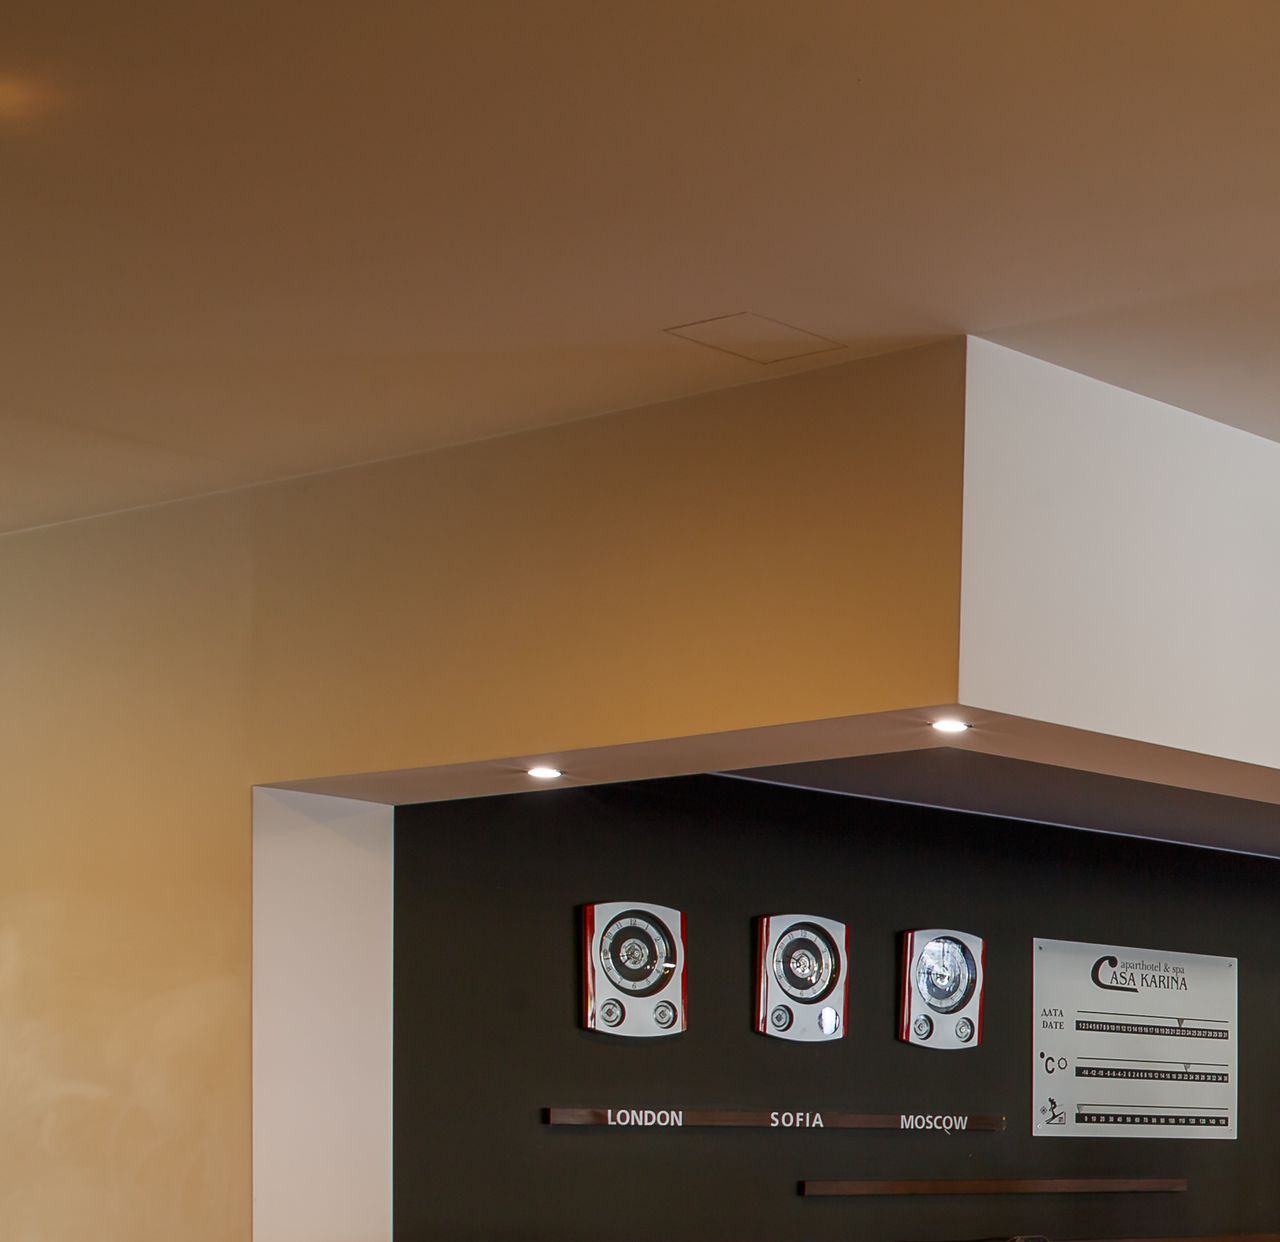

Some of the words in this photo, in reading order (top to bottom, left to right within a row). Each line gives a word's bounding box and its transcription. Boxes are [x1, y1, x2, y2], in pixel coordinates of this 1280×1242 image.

[1120, 960, 1161, 972] aparthotel
[1163, 962, 1170, 972] &
[1172, 966, 1185, 976] spa
[1141, 973, 1188, 991] KARINA
[1042, 1020, 1065, 1030] DATE
[607, 1109, 683, 1126] LONDON
[770, 1111, 824, 1128] SOFIA
[900, 1115, 968, 1130] MOSCOW
